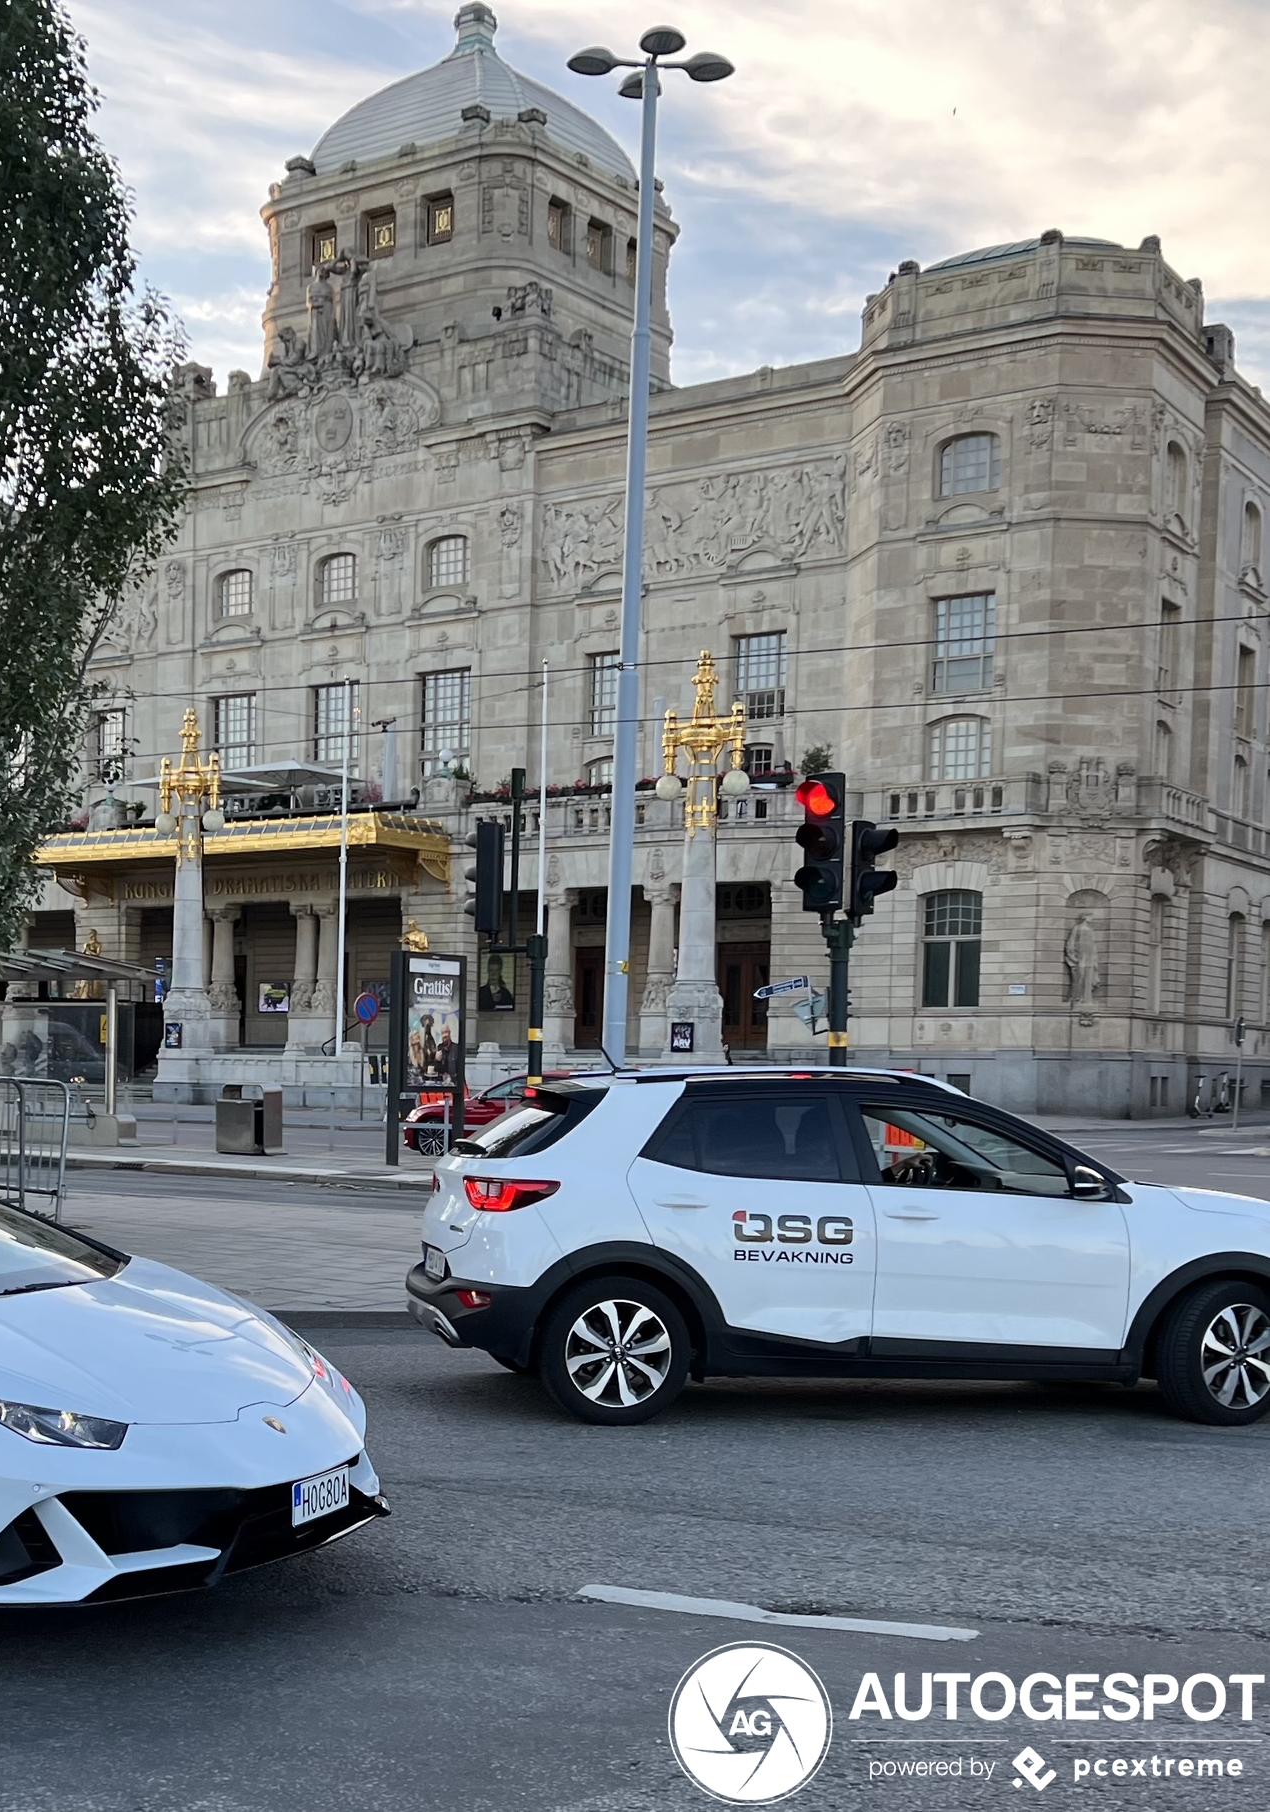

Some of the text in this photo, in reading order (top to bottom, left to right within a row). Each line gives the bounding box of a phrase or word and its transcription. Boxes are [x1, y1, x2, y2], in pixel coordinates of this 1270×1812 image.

[326, 869, 400, 890] TATERN
[413, 977, 453, 996] Grattis!
[732, 1210, 853, 1245] QSG
[734, 1250, 853, 1264] BEVAKNING
